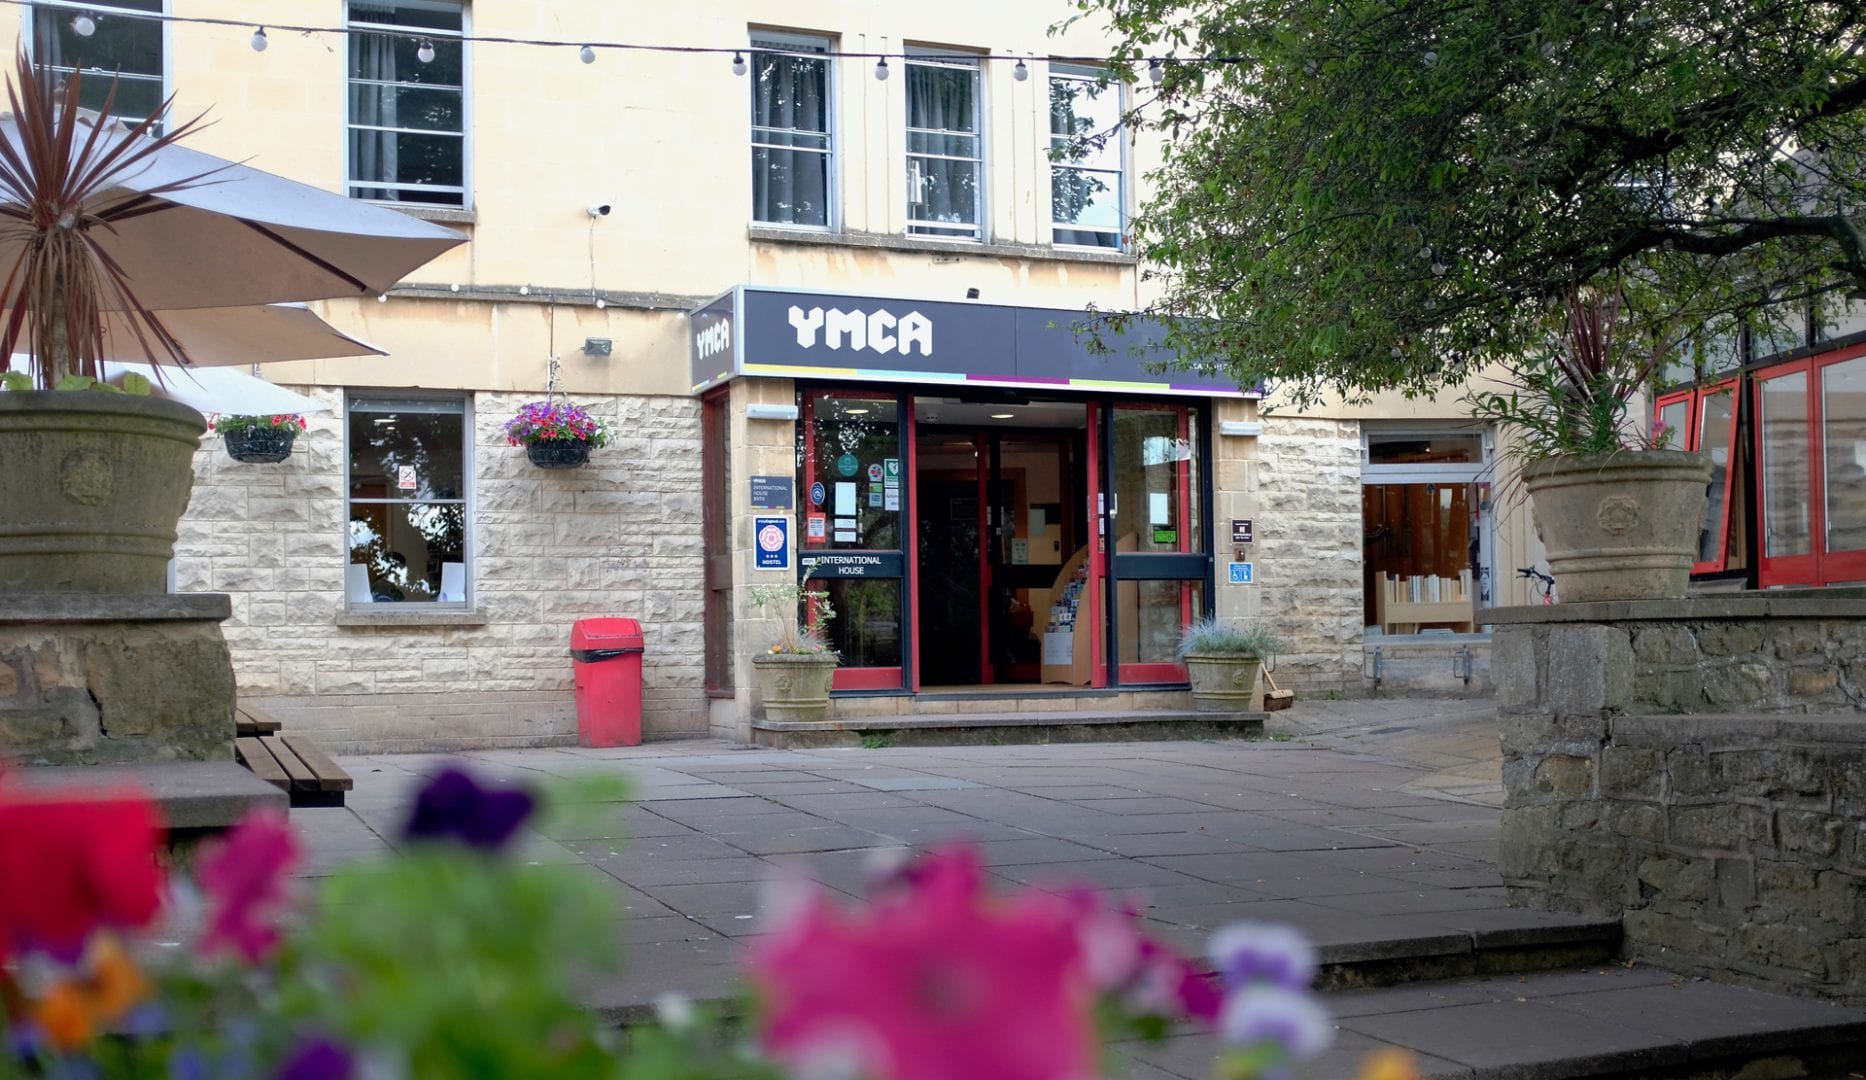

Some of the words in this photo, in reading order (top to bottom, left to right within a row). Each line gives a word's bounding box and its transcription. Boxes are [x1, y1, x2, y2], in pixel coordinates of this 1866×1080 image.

[697, 317, 730, 360] YMCA
[788, 305, 932, 357] YMCA
[821, 556, 881, 565] INTERNATIONAL
[838, 566, 865, 575] HOUSE
